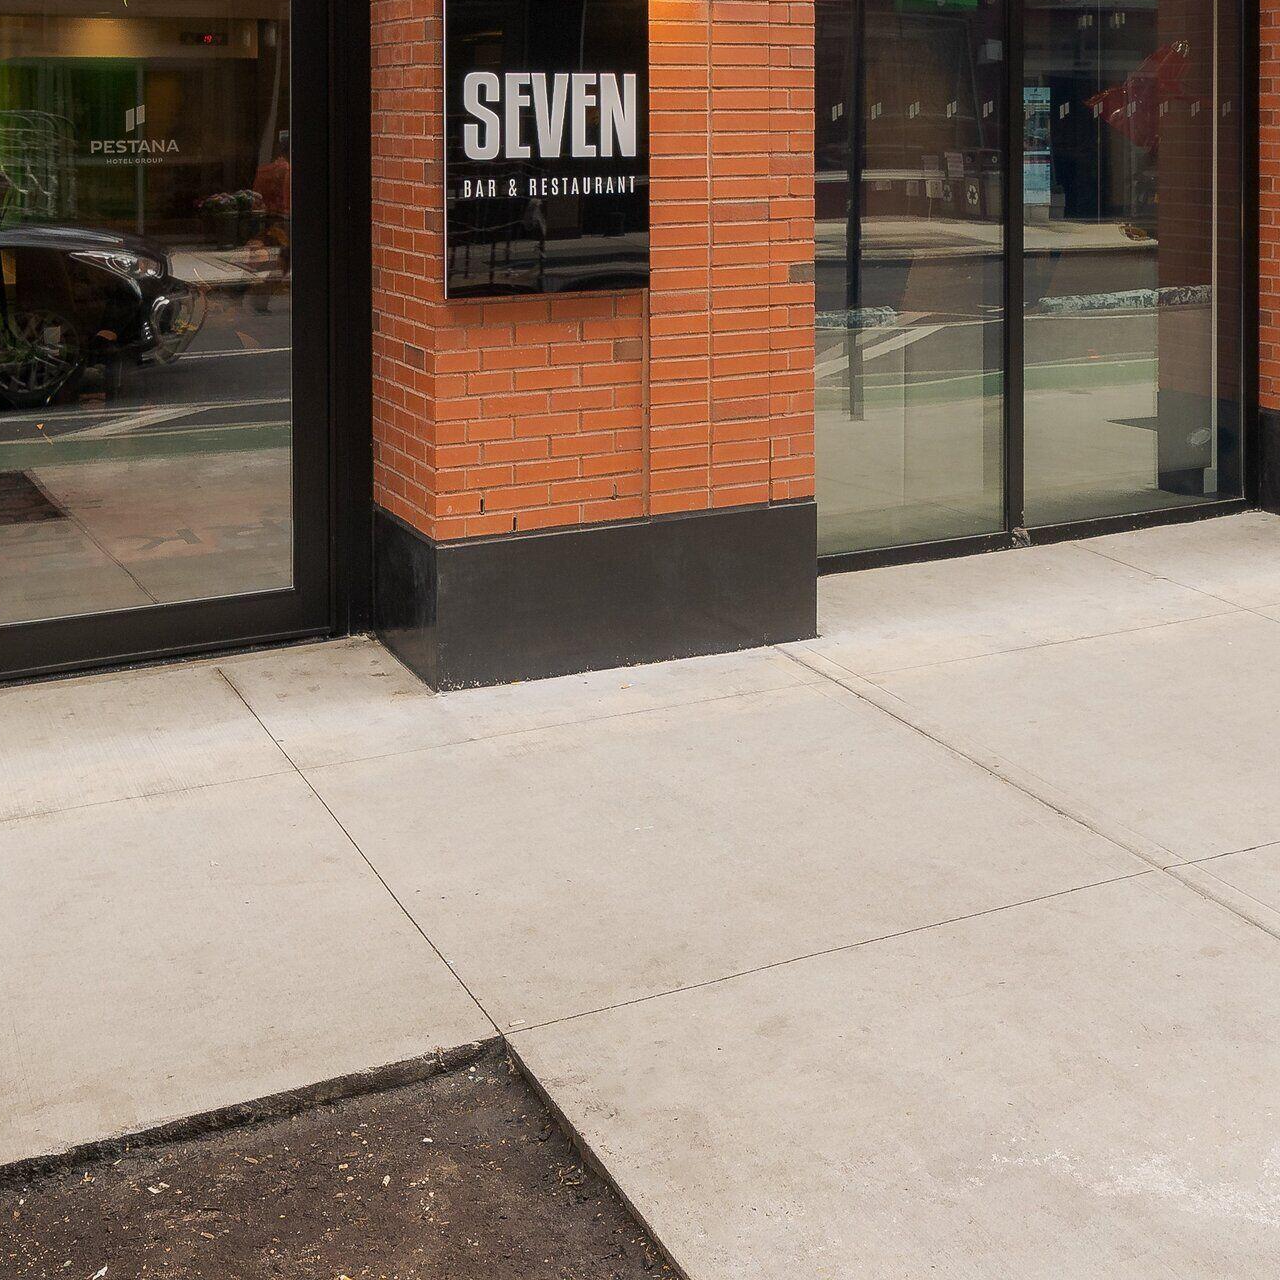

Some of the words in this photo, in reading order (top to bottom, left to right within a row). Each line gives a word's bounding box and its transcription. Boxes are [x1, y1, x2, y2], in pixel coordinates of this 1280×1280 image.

[463, 72, 637, 160] SEVEN
[90, 139, 180, 154] PESTANA
[464, 179, 497, 198] BAR
[508, 178, 518, 197] &
[529, 176, 636, 197] RESTAURANT
